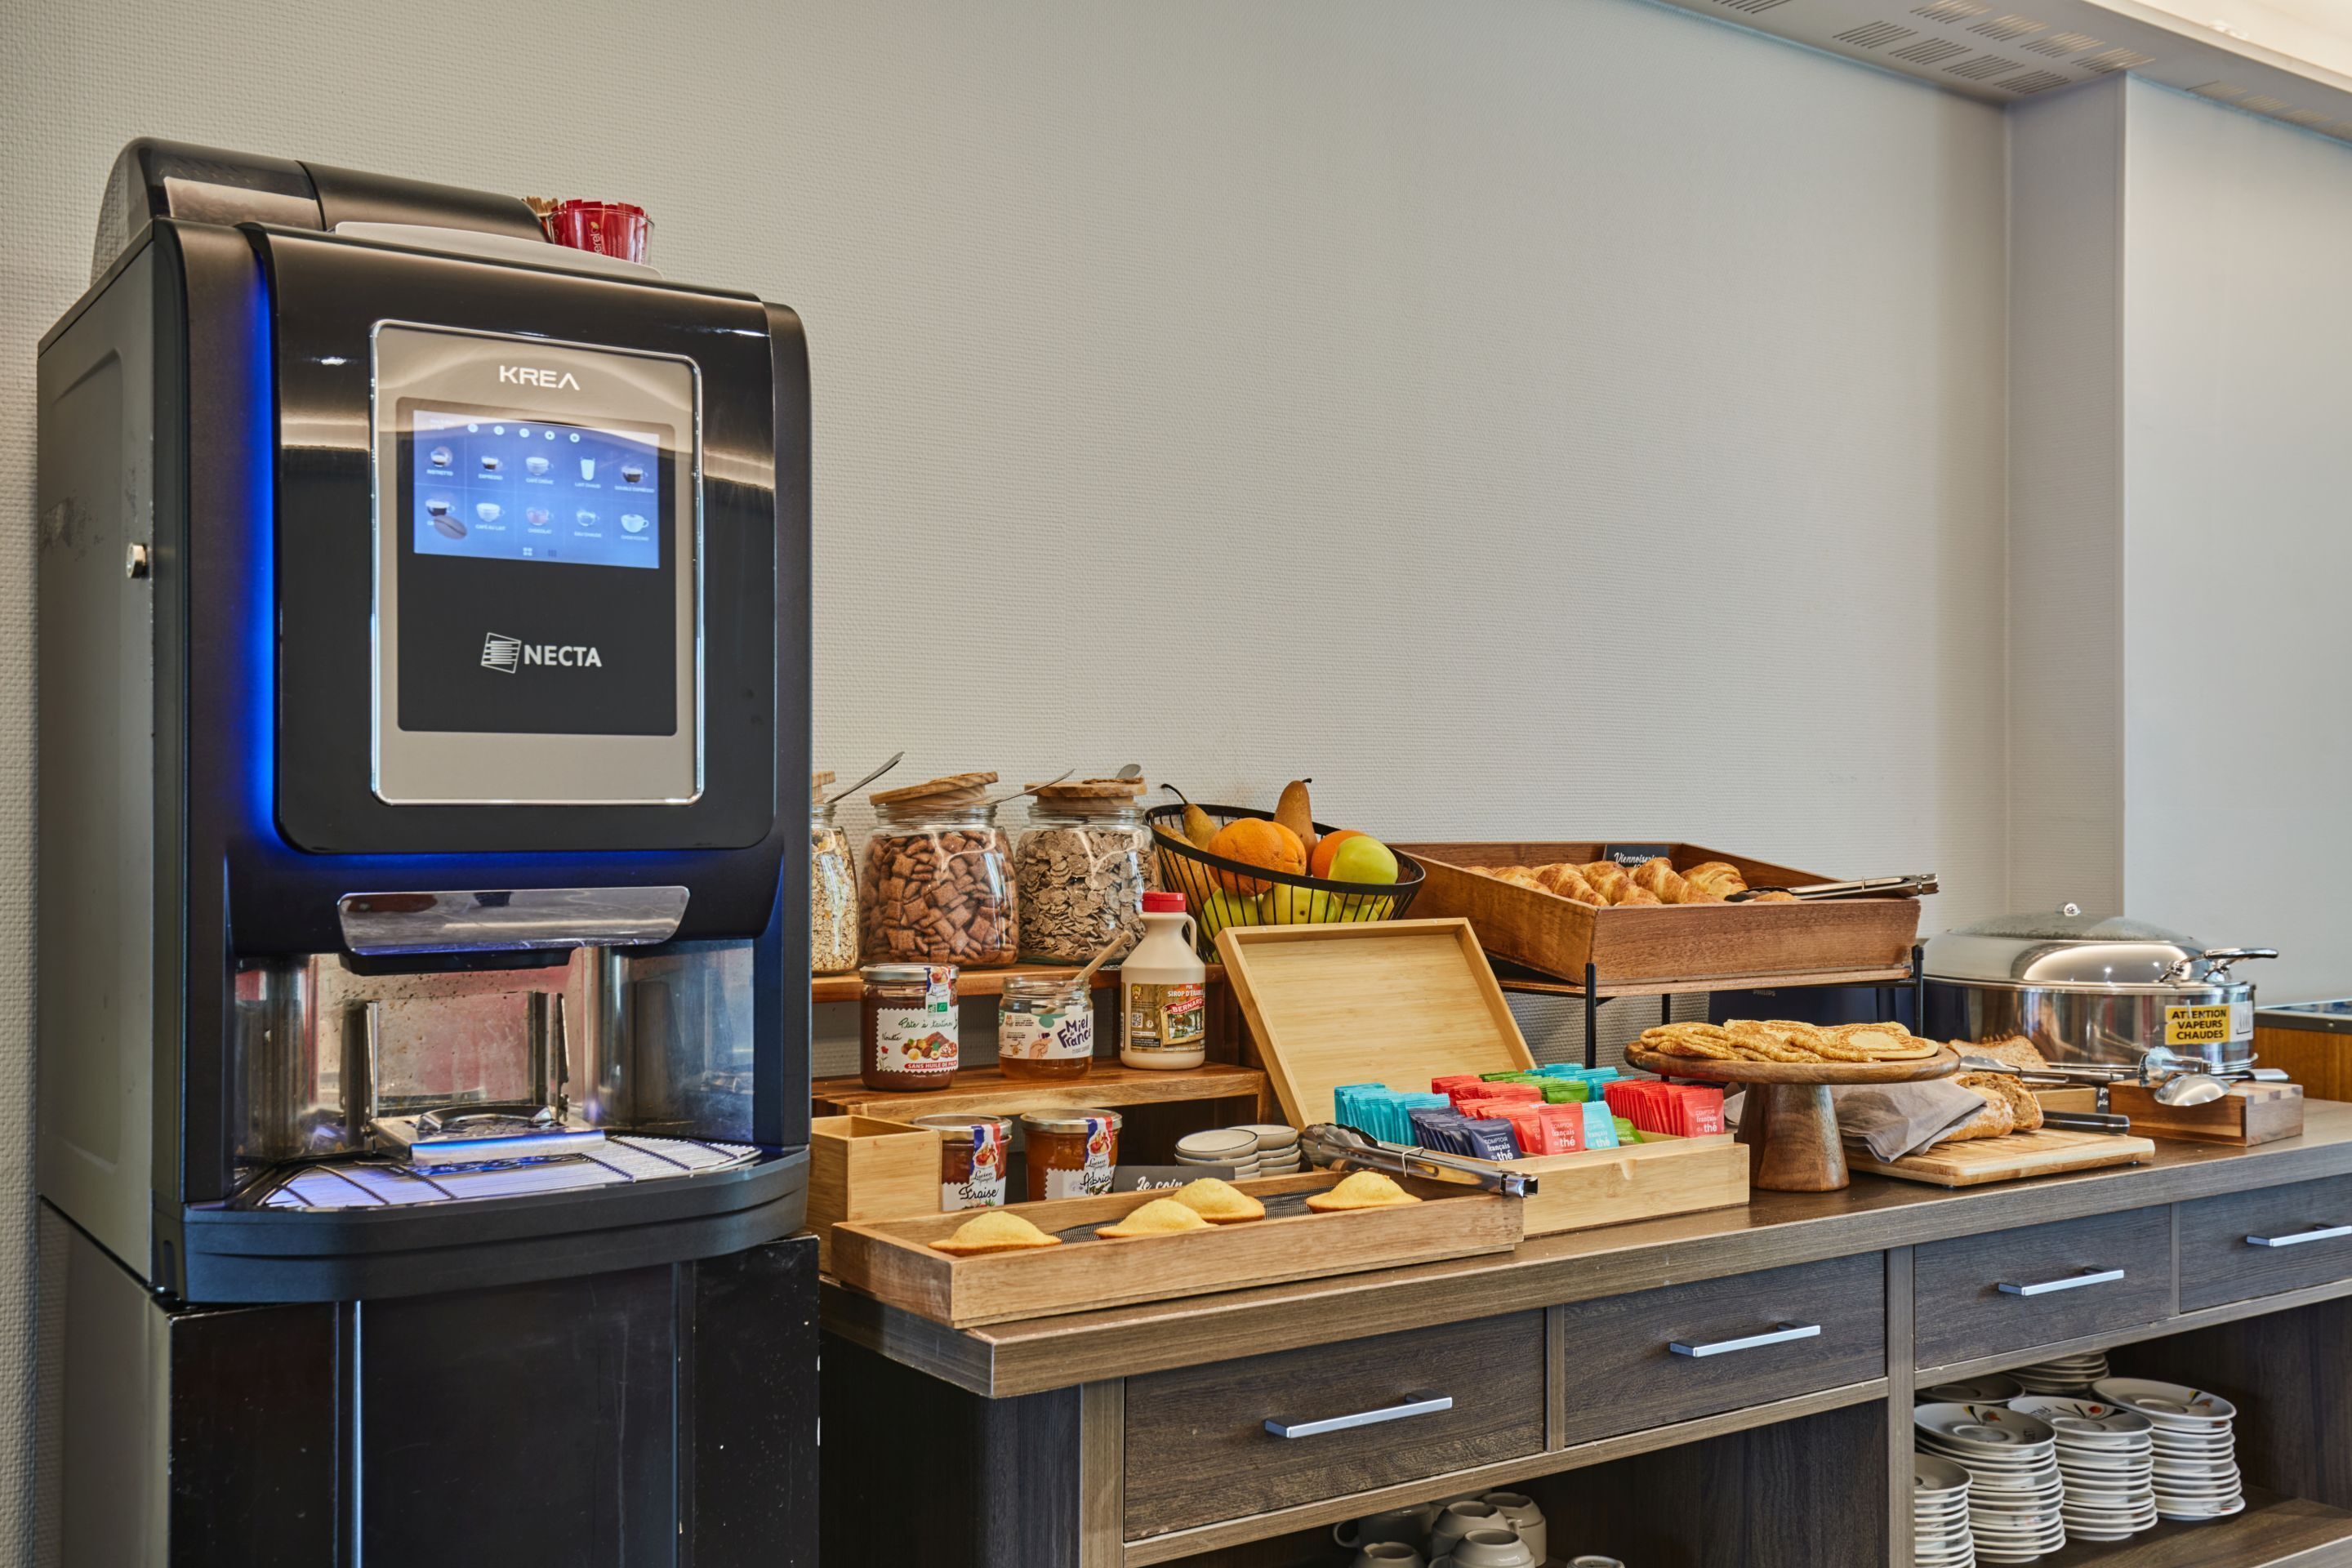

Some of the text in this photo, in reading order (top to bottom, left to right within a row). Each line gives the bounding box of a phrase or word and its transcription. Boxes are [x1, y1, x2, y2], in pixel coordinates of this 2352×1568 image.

[499, 365, 581, 390] KREA
[523, 644, 603, 668] NECTA
[1065, 1013, 1089, 1033] Miel
[2177, 1020, 2223, 1030] VAPEURS
[2176, 1030, 2224, 1040] CHAUDES
[1696, 1114, 1717, 1123] français
[1552, 1128, 1575, 1137] français
[1704, 1122, 1717, 1133] thé
[1485, 1136, 1508, 1145] COMPTOIR
[1560, 1136, 1575, 1147] thé
[1595, 1137, 1610, 1147] thé
[1487, 1143, 1510, 1152] français
[1497, 1150, 1513, 1161] thé
[958, 1182, 1000, 1200] Fraise
